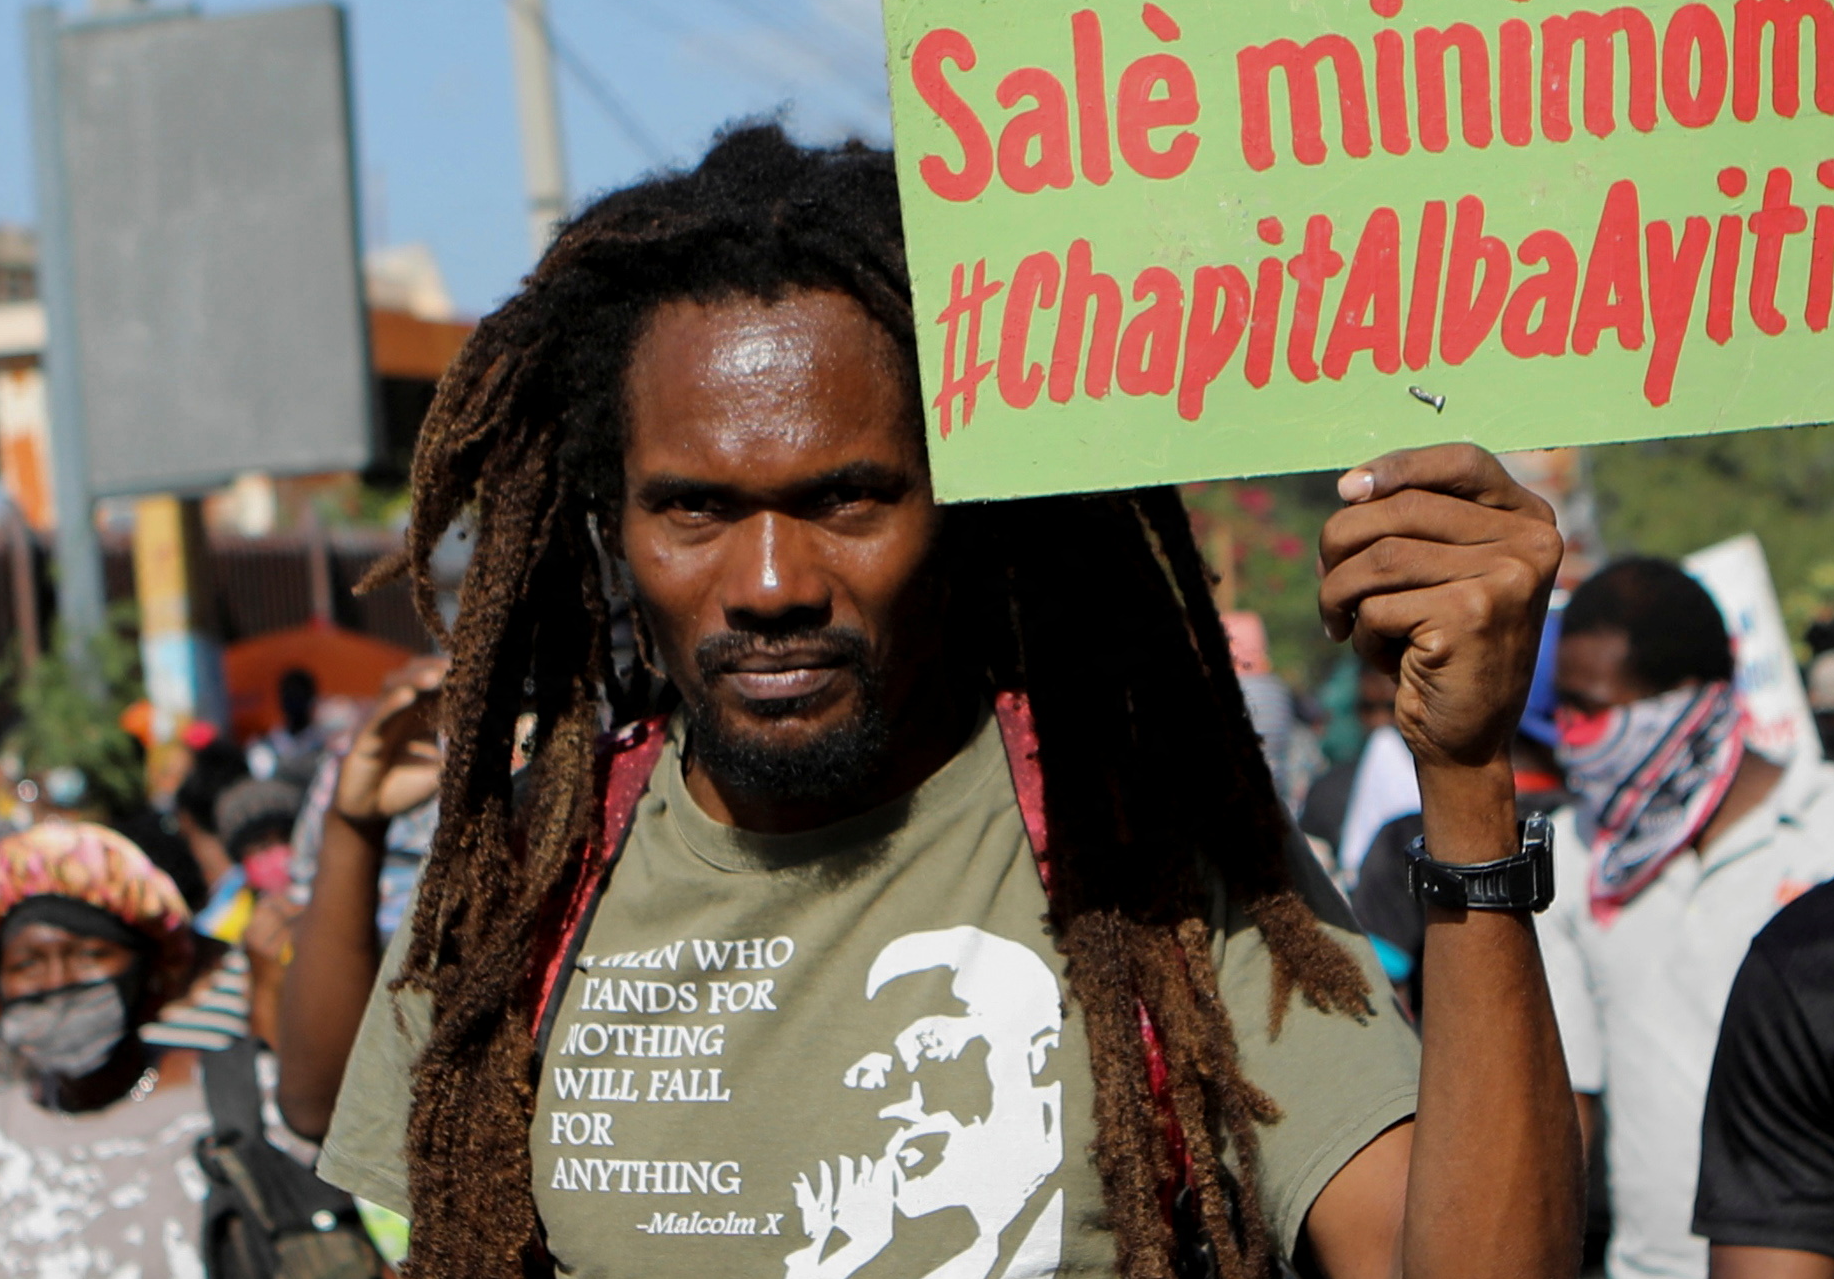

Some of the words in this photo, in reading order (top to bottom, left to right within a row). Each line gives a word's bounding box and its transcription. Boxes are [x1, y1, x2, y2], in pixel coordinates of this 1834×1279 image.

[911, 2, 1200, 203] Salè
[691, 935, 795, 972] WHO
[578, 977, 699, 1014] TANDS
[707, 978, 778, 1014] FOR
[560, 1022, 725, 1058] NOTHING
[553, 1067, 639, 1103] WILL
[646, 1068, 731, 1103] FALL
[549, 1111, 615, 1147] FOR
[551, 1156, 742, 1195] ANYTHING
[635, 1210, 756, 1237] -Malcolm
[760, 1211, 785, 1237] X
